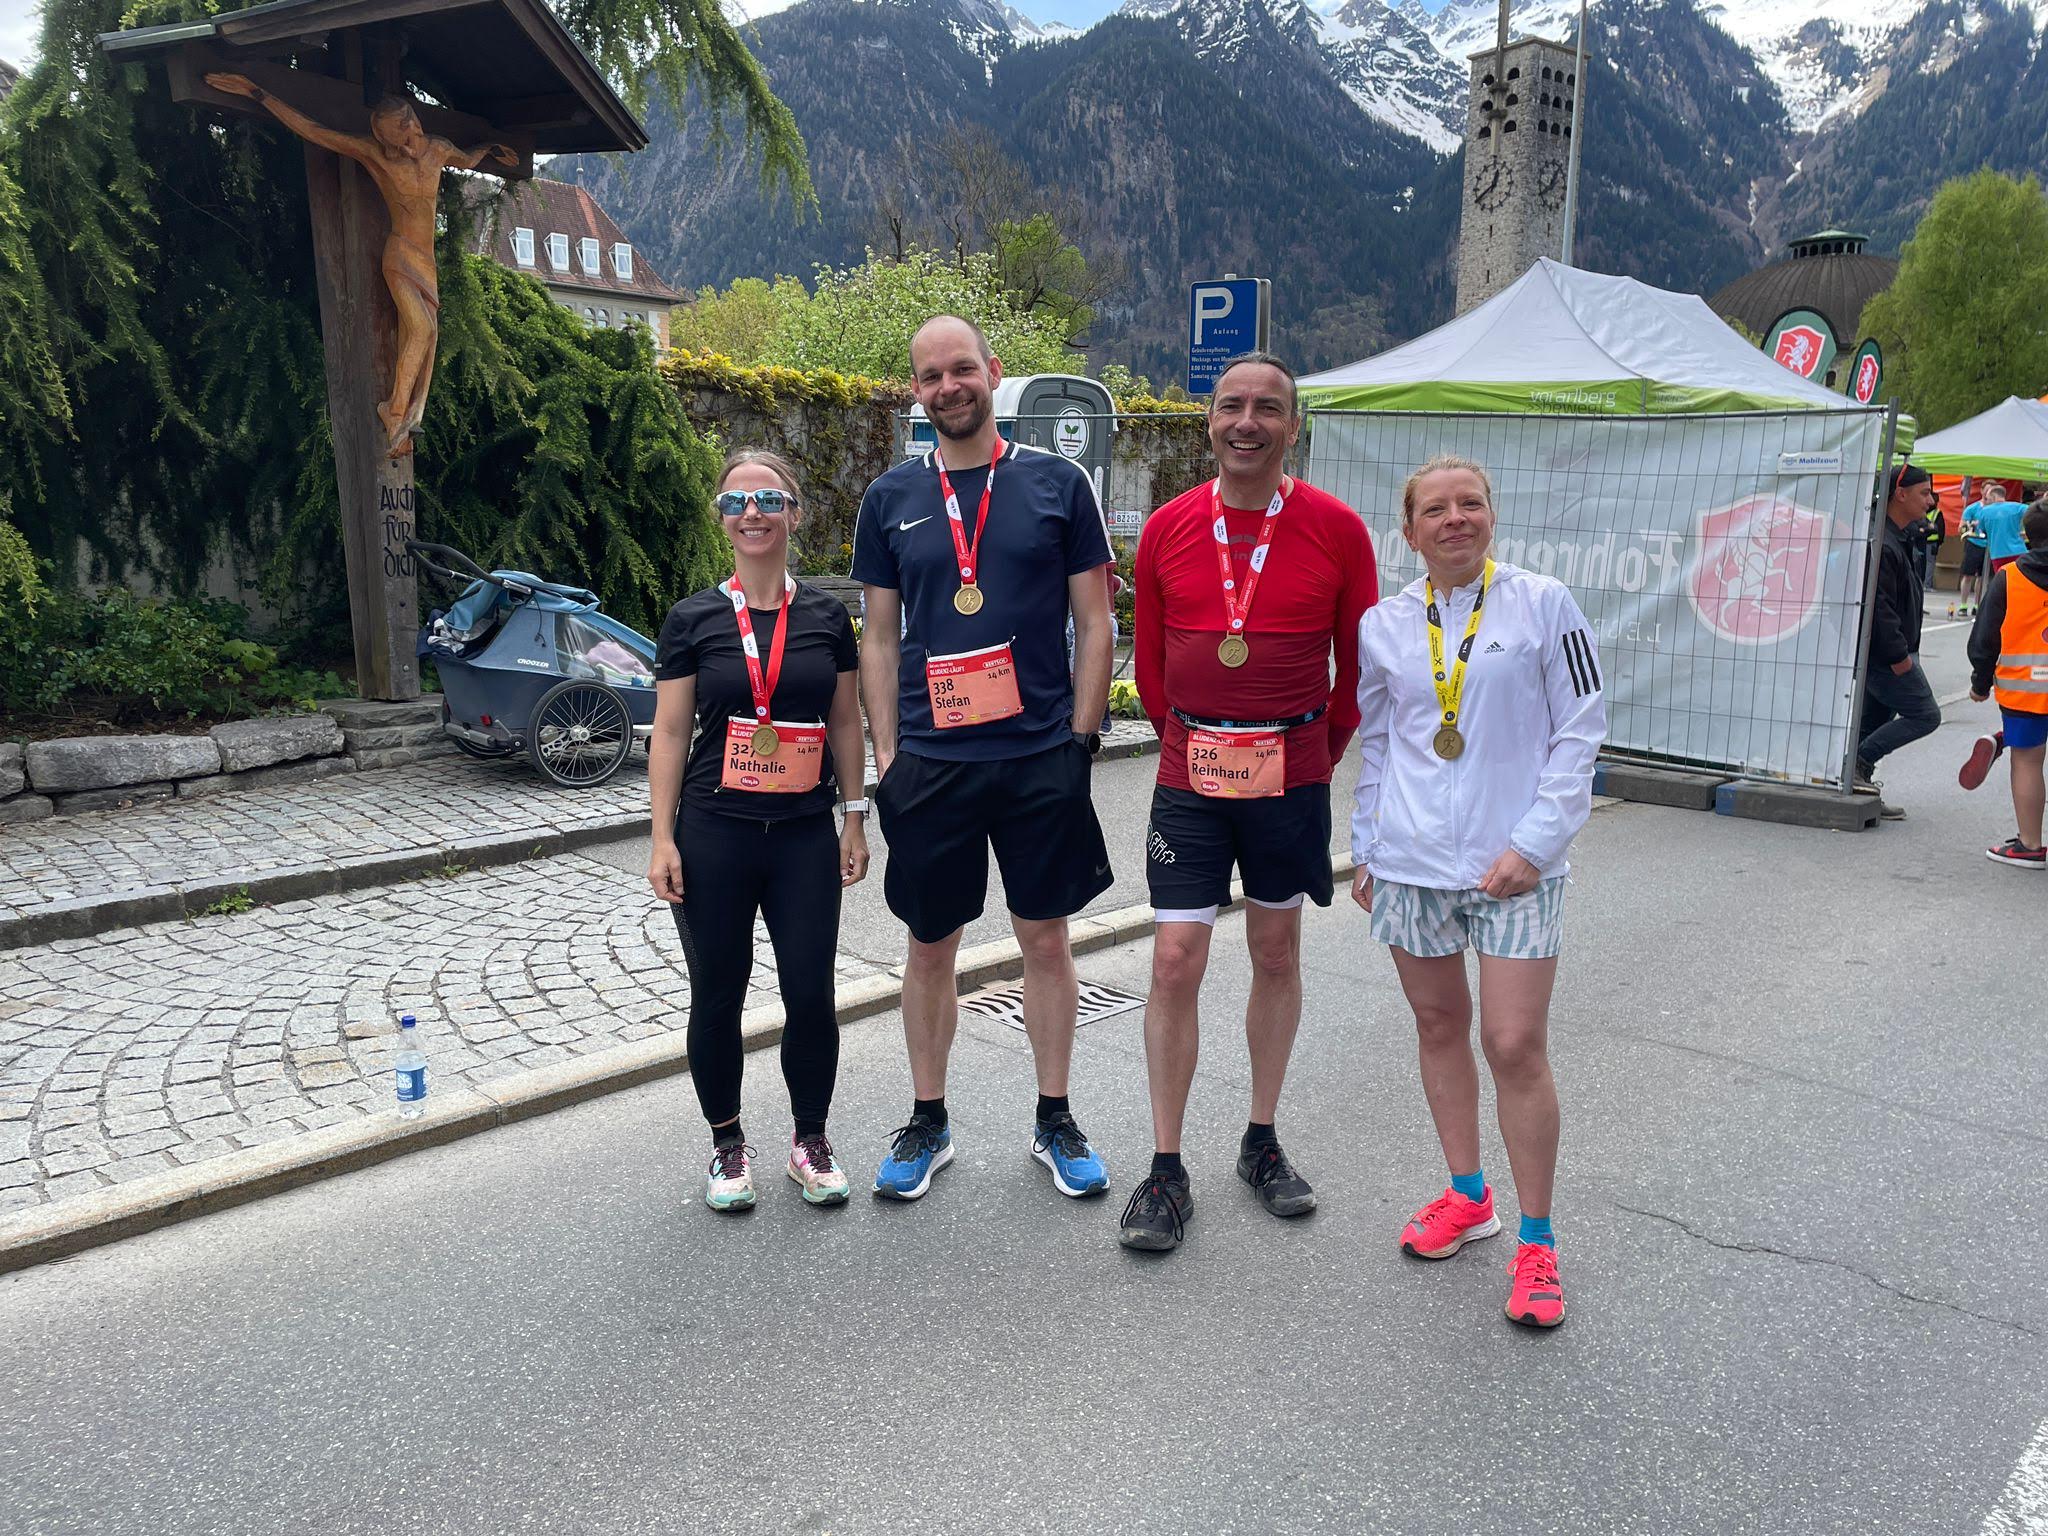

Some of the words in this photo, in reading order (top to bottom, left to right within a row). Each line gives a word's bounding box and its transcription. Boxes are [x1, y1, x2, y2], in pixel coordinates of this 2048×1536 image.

[1194, 287, 1234, 345] P
[1213, 328, 1239, 336] Anfang
[1530, 388, 1617, 408] vorarlberg
[517, 658, 550, 668] CROOZER
[987, 671, 997, 680] 14
[998, 667, 1011, 677] km
[932, 678, 955, 696] 338
[935, 694, 971, 709] Stefan
[797, 746, 806, 755] 14
[807, 745, 819, 753] km
[1191, 747, 1218, 761] 326
[1255, 751, 1265, 759] 14
[1266, 748, 1278, 757] km
[729, 757, 787, 774] Nathalie
[1191, 762, 1250, 780] Reinhard
